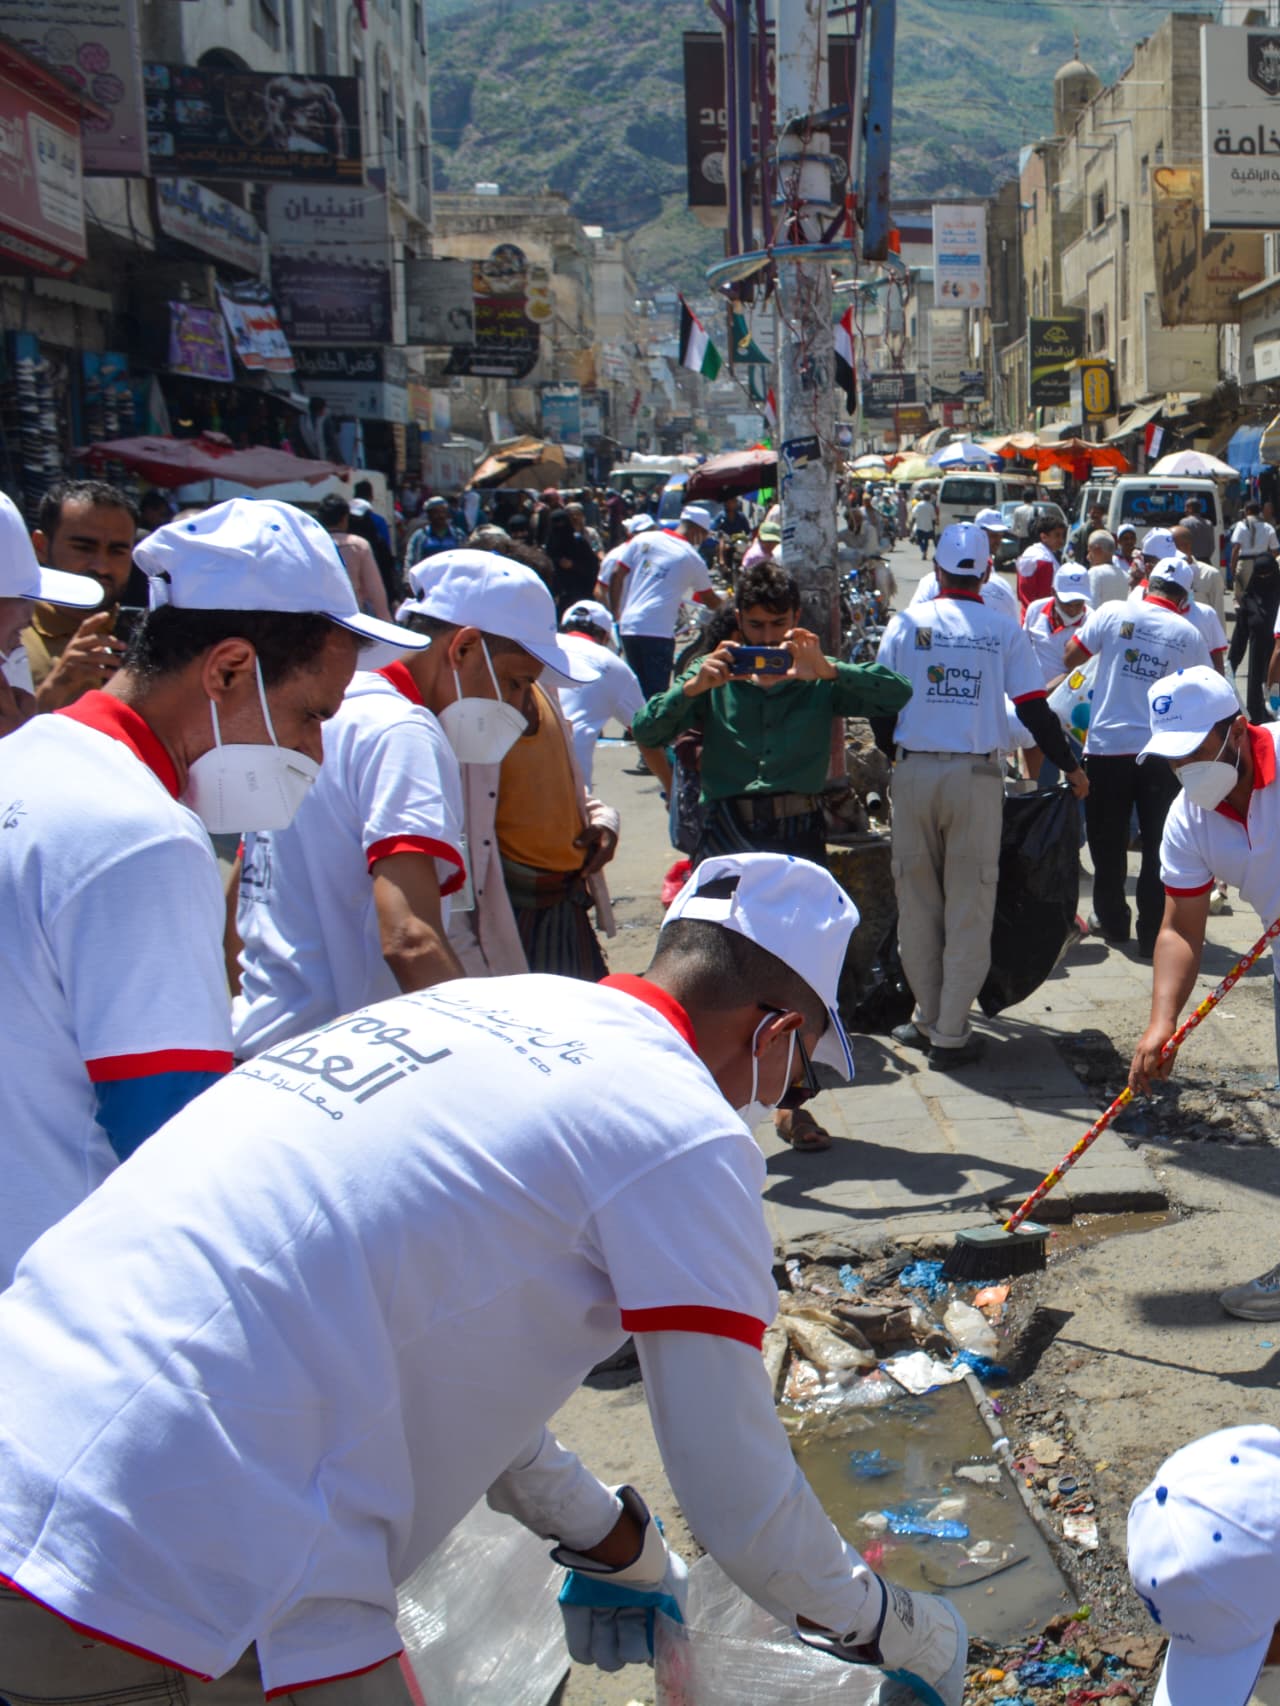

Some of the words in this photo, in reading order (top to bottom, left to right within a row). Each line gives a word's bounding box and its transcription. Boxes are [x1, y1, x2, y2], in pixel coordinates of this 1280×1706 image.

[1231, 167, 1270, 184] الراقية
[284, 195, 365, 225] البنيان
[1139, 653, 1169, 668] يوم
[945, 667, 983, 685] يوم
[926, 680, 982, 700] العطاء
[325, 1016, 453, 1073] يوم
